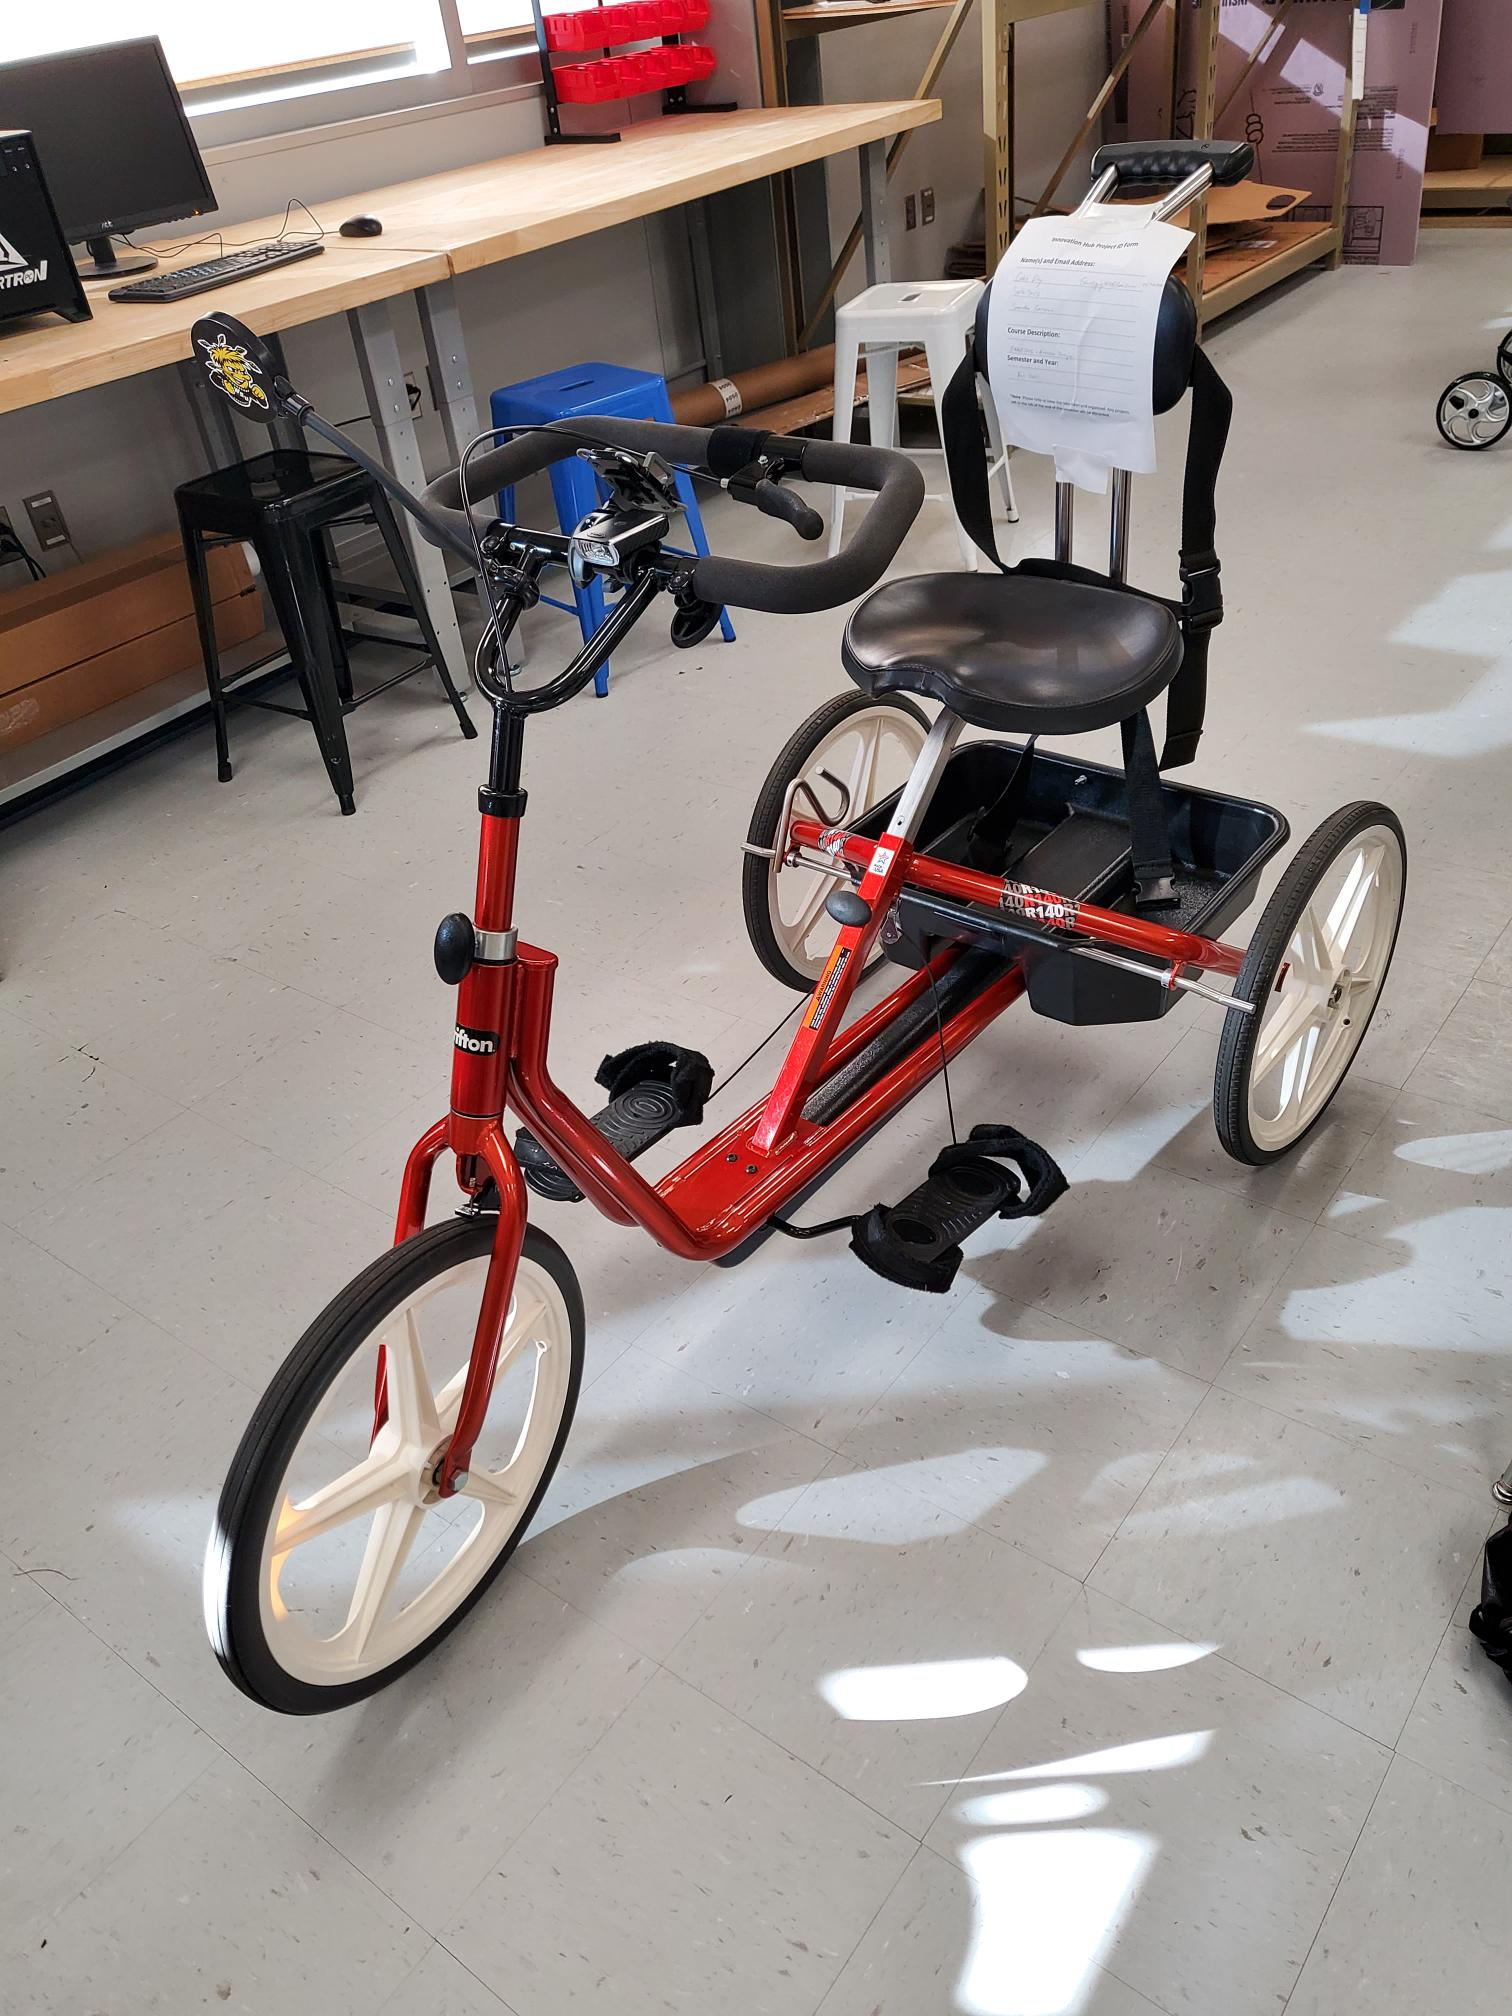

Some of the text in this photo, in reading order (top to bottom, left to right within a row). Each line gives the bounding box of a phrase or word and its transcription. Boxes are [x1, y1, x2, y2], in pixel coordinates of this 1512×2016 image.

[1051, 236, 1082, 247] Innovation
[1096, 242, 1116, 250] Project
[1020, 257, 1096, 267] Name(s) and Email Address:
[1007, 327, 1061, 338] Course Description:
[1007, 355, 1060, 367] Semester and Year:
[1025, 904, 1065, 918] R140
